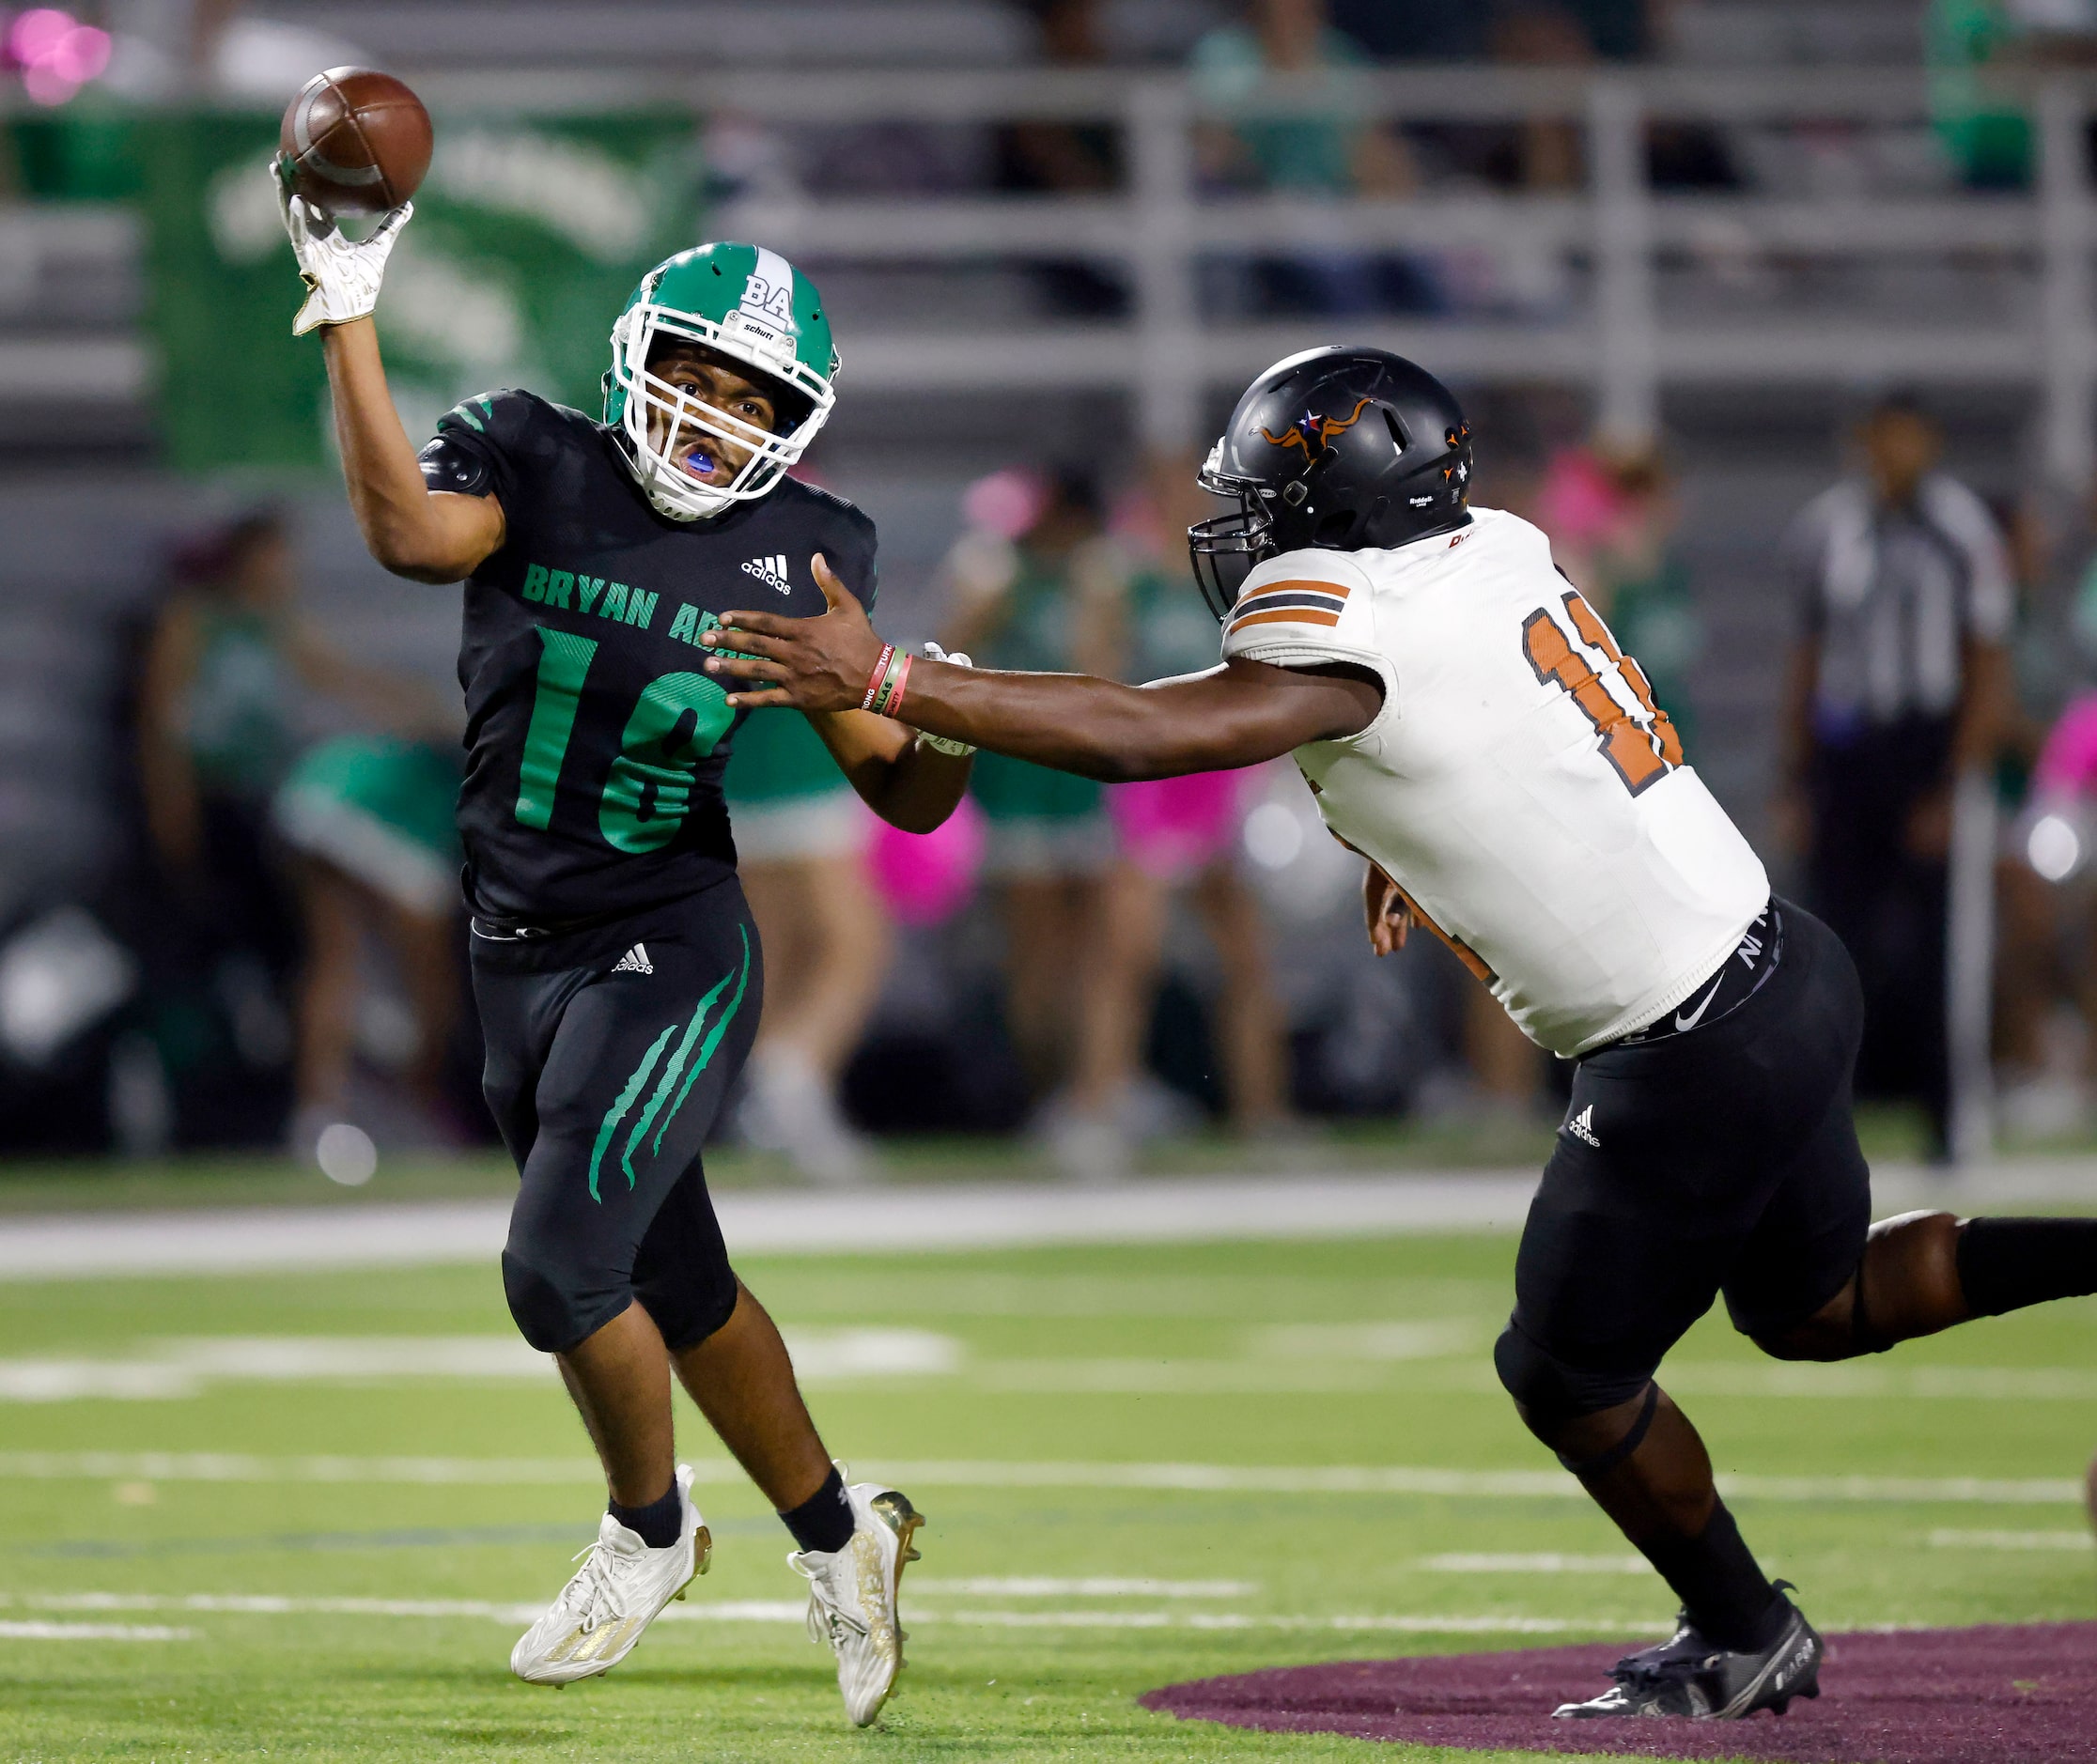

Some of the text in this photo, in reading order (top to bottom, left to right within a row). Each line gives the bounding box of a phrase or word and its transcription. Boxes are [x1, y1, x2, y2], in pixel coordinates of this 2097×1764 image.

[740, 274, 793, 323] BA
[743, 323, 774, 341] schutt
[521, 563, 660, 630] BRYAN
[740, 562, 792, 596] adidas
[1521, 590, 1684, 798] 11
[514, 624, 737, 854] 18
[1568, 1120, 1601, 1148] adidas
